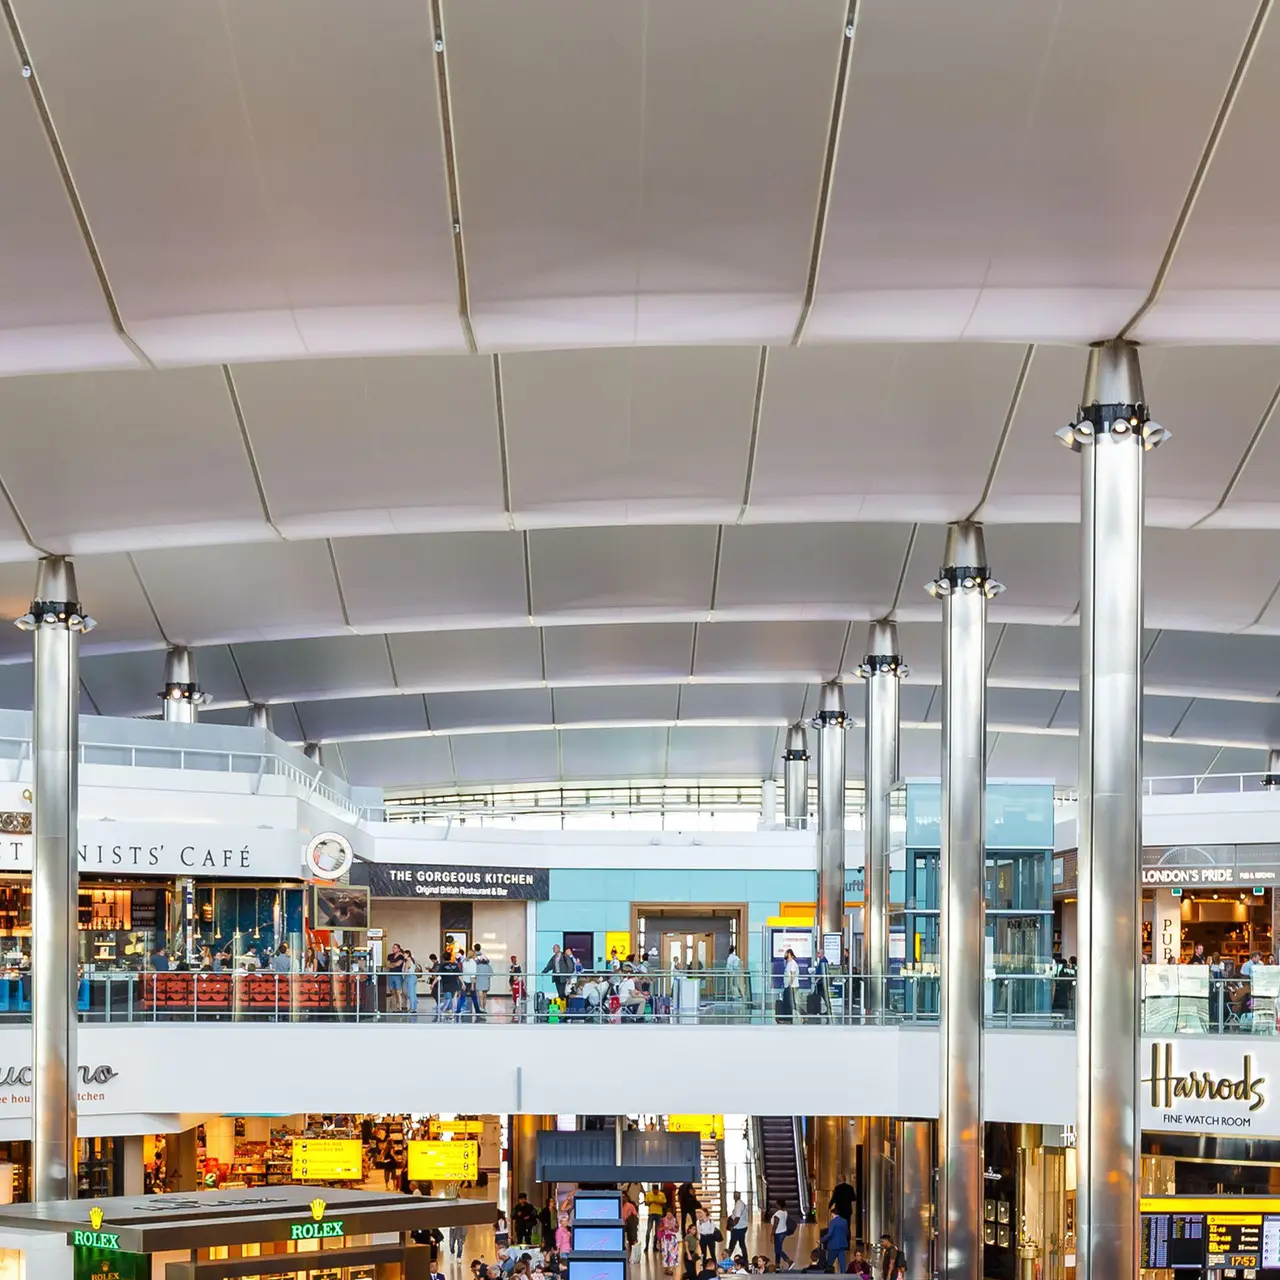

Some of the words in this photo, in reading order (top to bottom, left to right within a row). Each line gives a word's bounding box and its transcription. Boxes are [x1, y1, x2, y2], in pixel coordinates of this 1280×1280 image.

[180, 845, 250, 868] CAFÉ
[389, 870, 412, 881] THE
[417, 871, 481, 883] GORGEOUS
[485, 873, 534, 885] KITCHEN
[1142, 869, 1199, 883] LONDON'S
[1201, 869, 1233, 882] PRIDE
[416, 885, 439, 895] Original
[440, 886, 459, 895] British
[460, 886, 490, 895] Restaurant
[497, 888, 508, 896] Bar
[1162, 918, 1173, 960] PUB
[1141, 1043, 1266, 1112] Harrods
[11, 1093, 31, 1104] hou
[1163, 1113, 1183, 1124] FINE
[1184, 1115, 1220, 1126] WATCH
[1221, 1116, 1251, 1127] ROOM
[291, 1222, 344, 1240] ROLEX
[73, 1230, 120, 1249] ROLEX
[1231, 1256, 1257, 1266] 17:53
